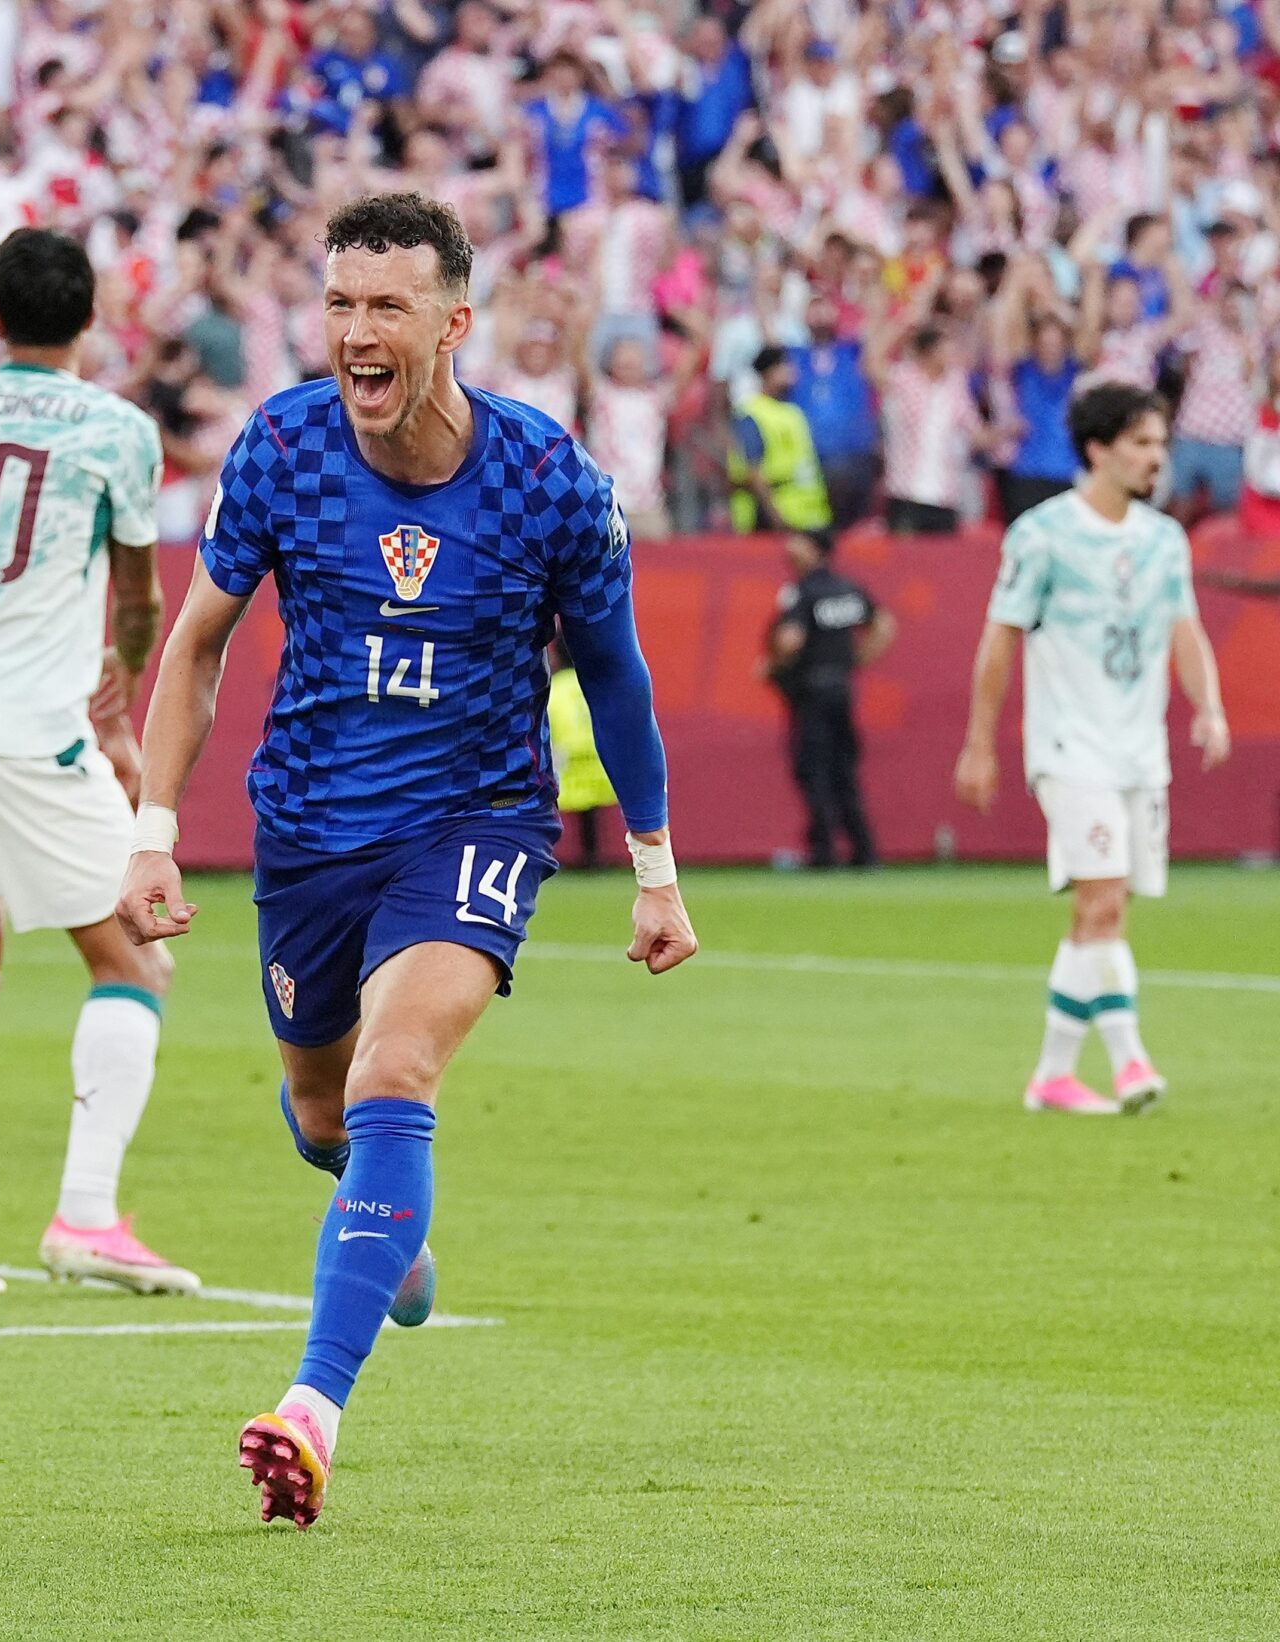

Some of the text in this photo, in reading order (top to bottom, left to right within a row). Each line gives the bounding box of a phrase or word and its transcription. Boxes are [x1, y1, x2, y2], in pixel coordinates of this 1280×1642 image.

[365, 634, 439, 708] 14
[1103, 623, 1142, 682] 21
[455, 845, 528, 925] 14
[345, 1200, 392, 1217] HNS
